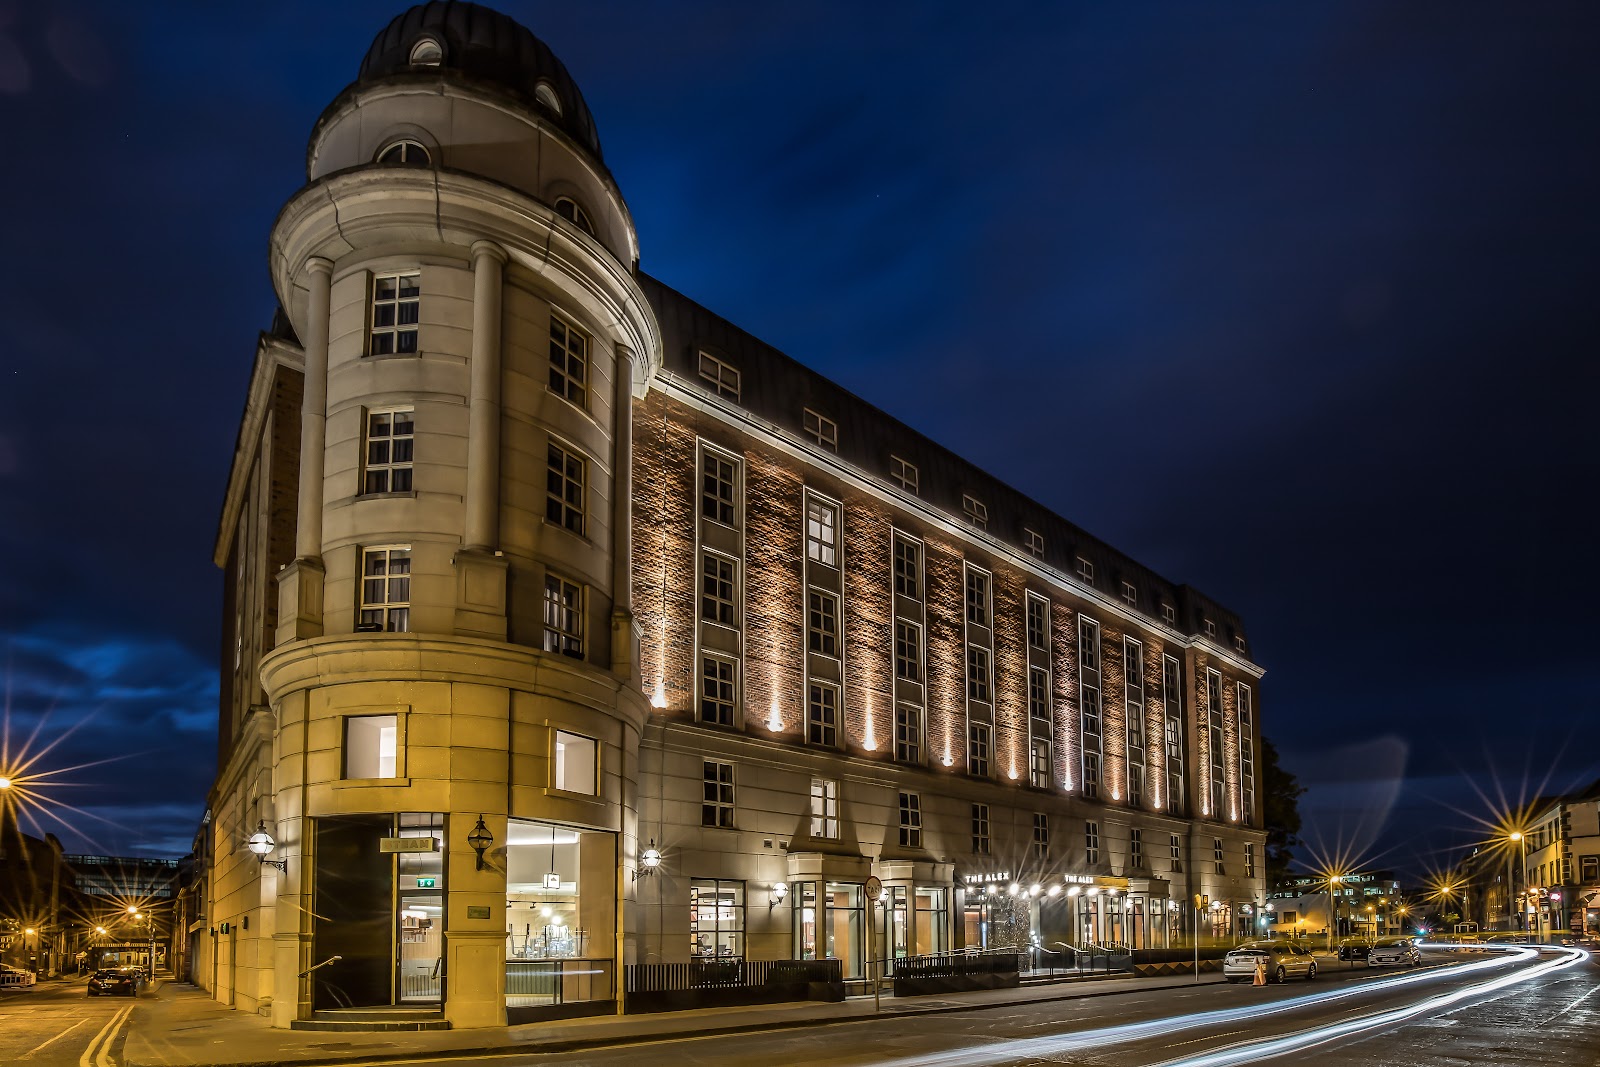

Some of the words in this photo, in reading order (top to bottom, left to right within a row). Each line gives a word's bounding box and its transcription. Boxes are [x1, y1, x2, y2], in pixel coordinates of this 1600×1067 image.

[384, 840, 429, 849] STEAM
[965, 875, 983, 883] THE
[985, 872, 1009, 882] ALEX
[1064, 875, 1078, 883] THE
[1078, 876, 1094, 884] ALEX
